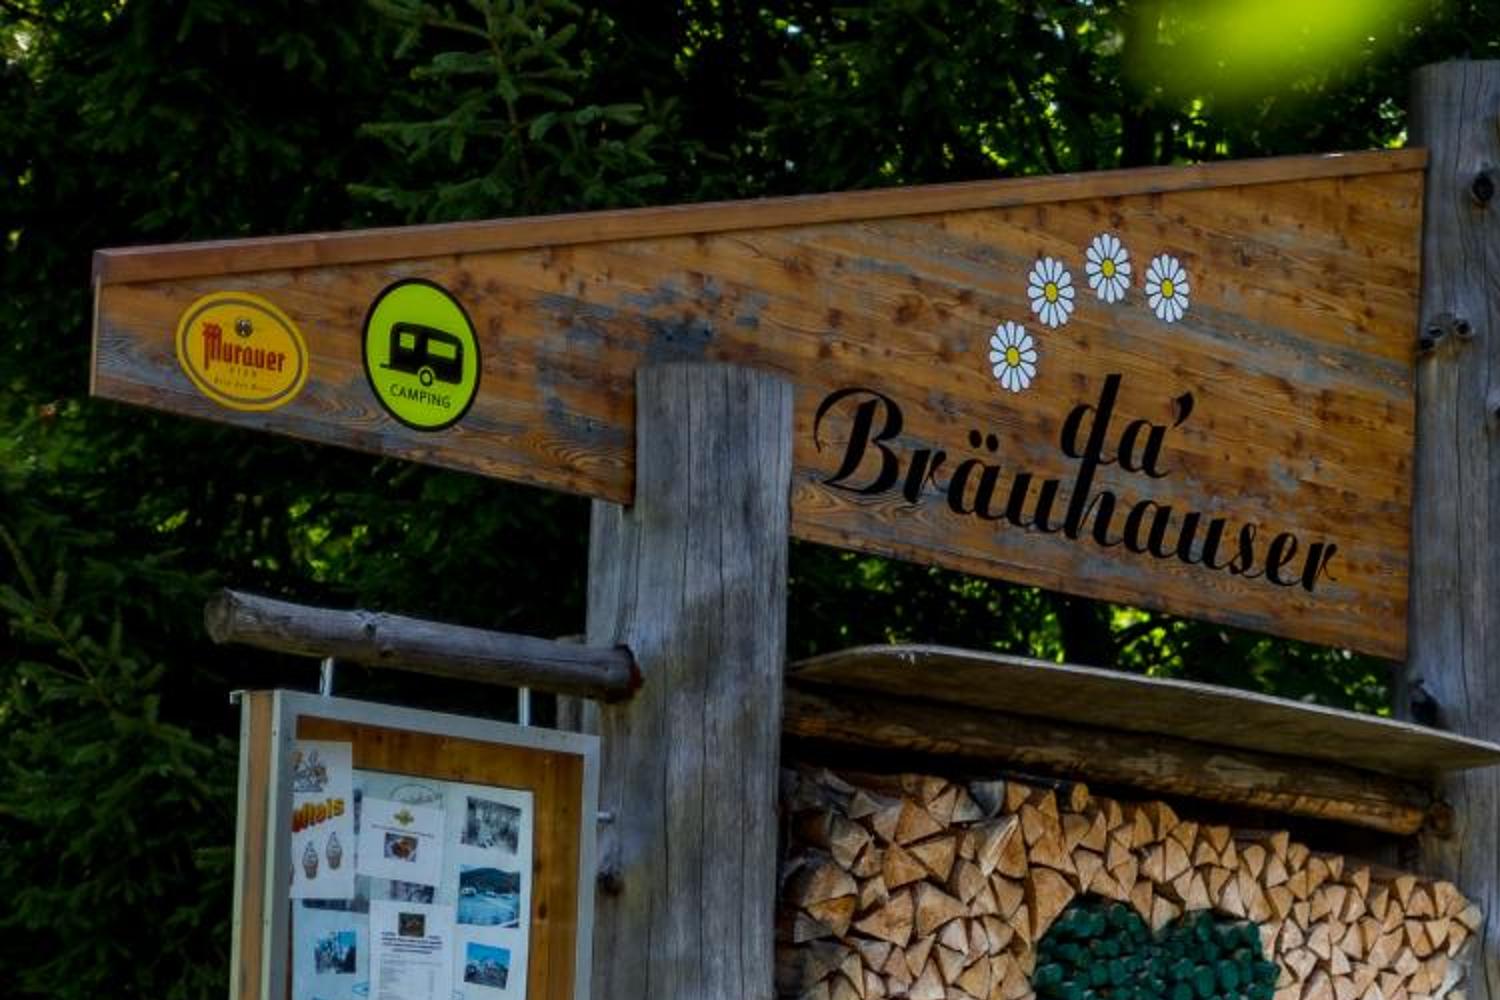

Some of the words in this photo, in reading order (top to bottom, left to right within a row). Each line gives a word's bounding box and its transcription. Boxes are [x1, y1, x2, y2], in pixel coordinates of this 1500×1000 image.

[201, 321, 286, 372] Murauer
[389, 383, 452, 409] CAMPING
[812, 386, 1340, 592] Bräuhauser
